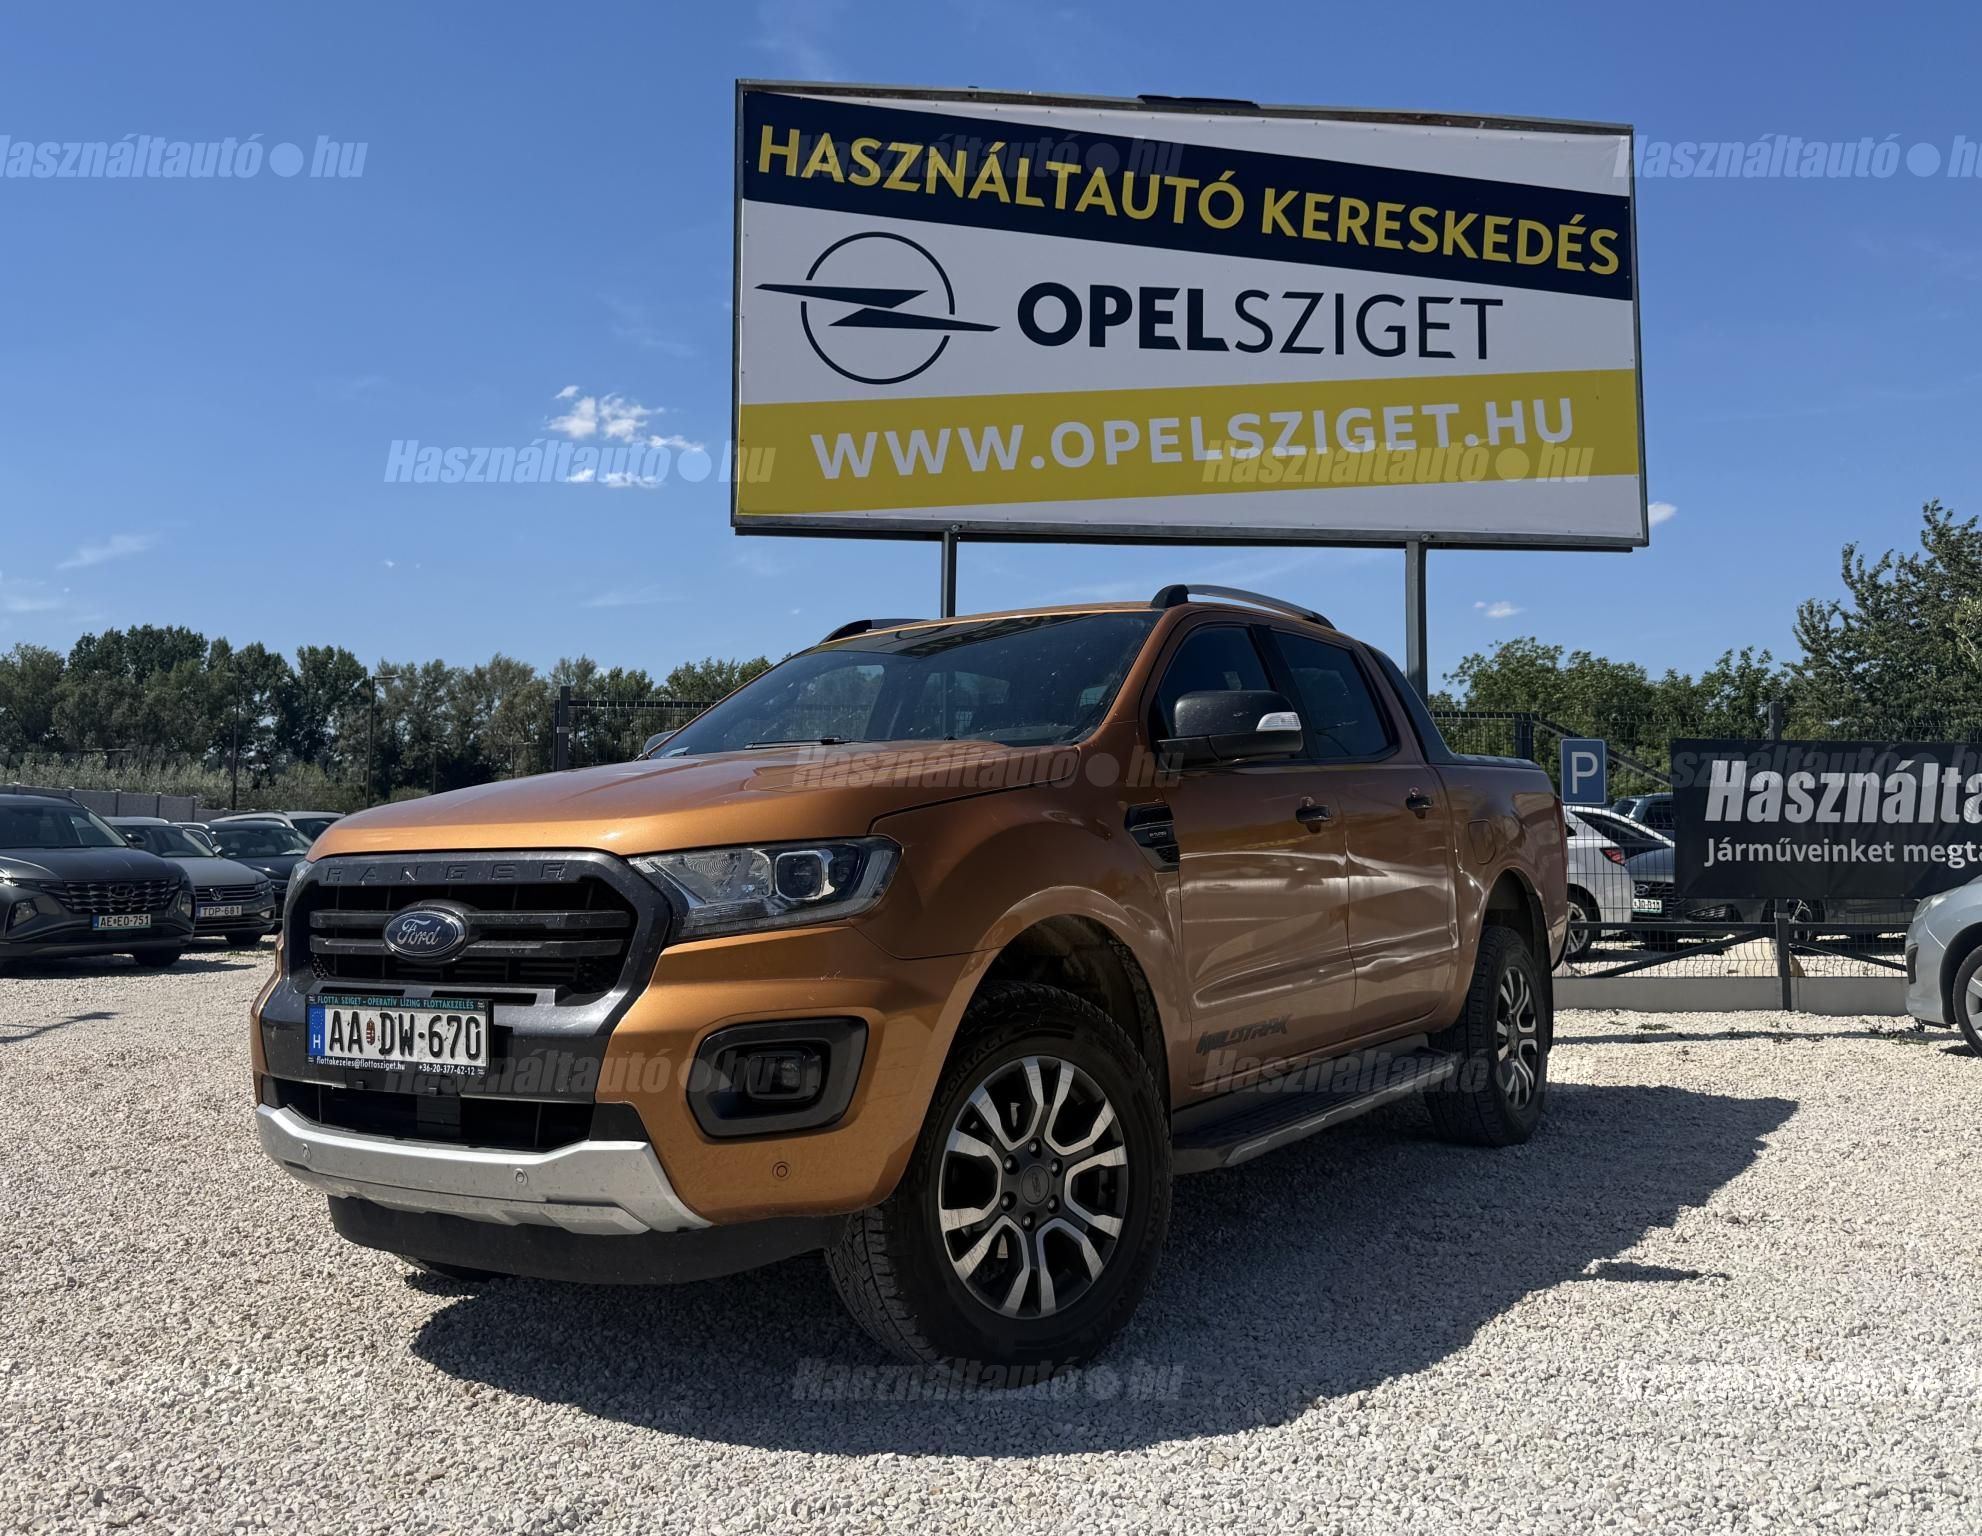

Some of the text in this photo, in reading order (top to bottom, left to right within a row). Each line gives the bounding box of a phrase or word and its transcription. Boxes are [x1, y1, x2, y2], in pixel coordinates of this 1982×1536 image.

[758, 124, 1620, 276] HASZNÁLTAUTÓ KERESKEDÉS
[1017, 281, 1504, 360] OPELSZIGET
[810, 398, 1574, 480] WWW.OPELSZIGET.HU
[1570, 751, 1599, 795] P
[1704, 837, 1982, 869] Járműveinket megt
[325, 861, 568, 882] RANGER
[396, 918, 443, 945] Ford
[317, 996, 339, 1004] FLOTTA
[341, 996, 362, 1005] SZIGET
[313, 1034, 321, 1048] H
